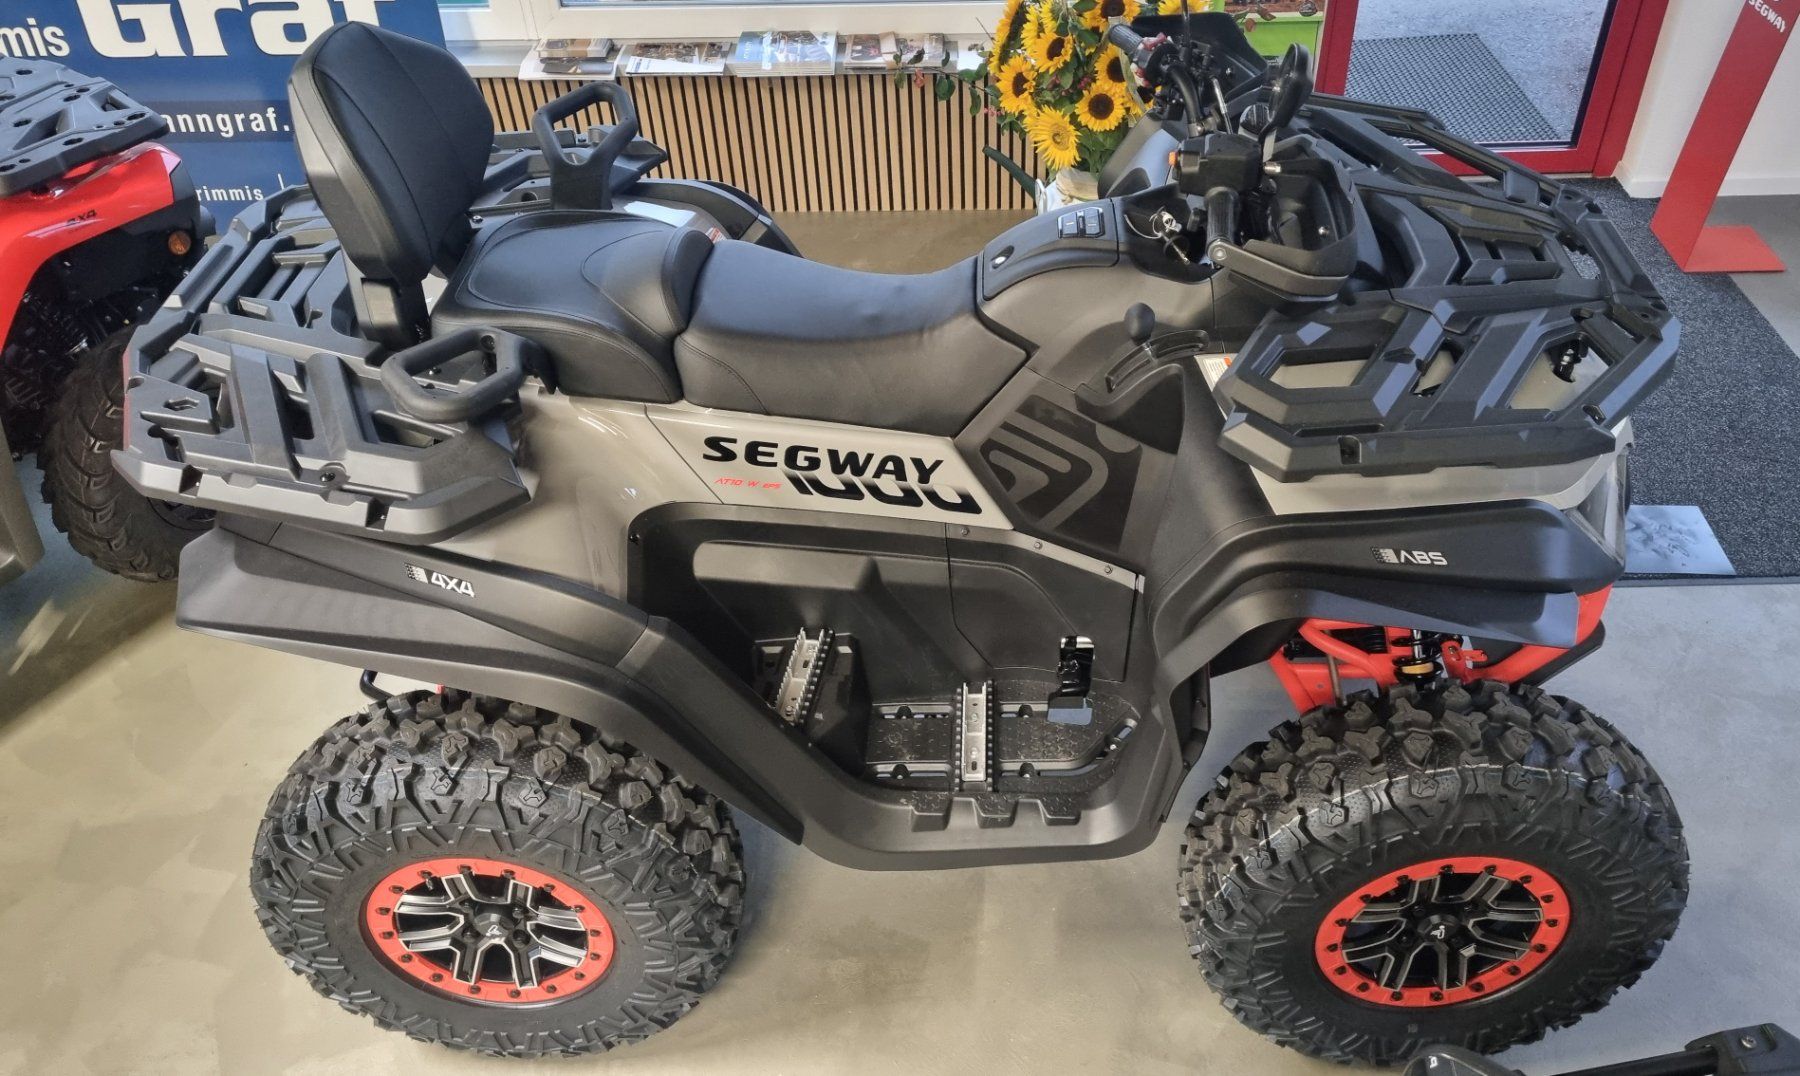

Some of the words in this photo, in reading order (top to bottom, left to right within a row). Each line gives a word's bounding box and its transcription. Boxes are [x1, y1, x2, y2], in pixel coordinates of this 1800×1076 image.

[702, 436, 944, 485] SEGWAY
[1400, 549, 1448, 566] ABS
[430, 571, 475, 598] 4X4
